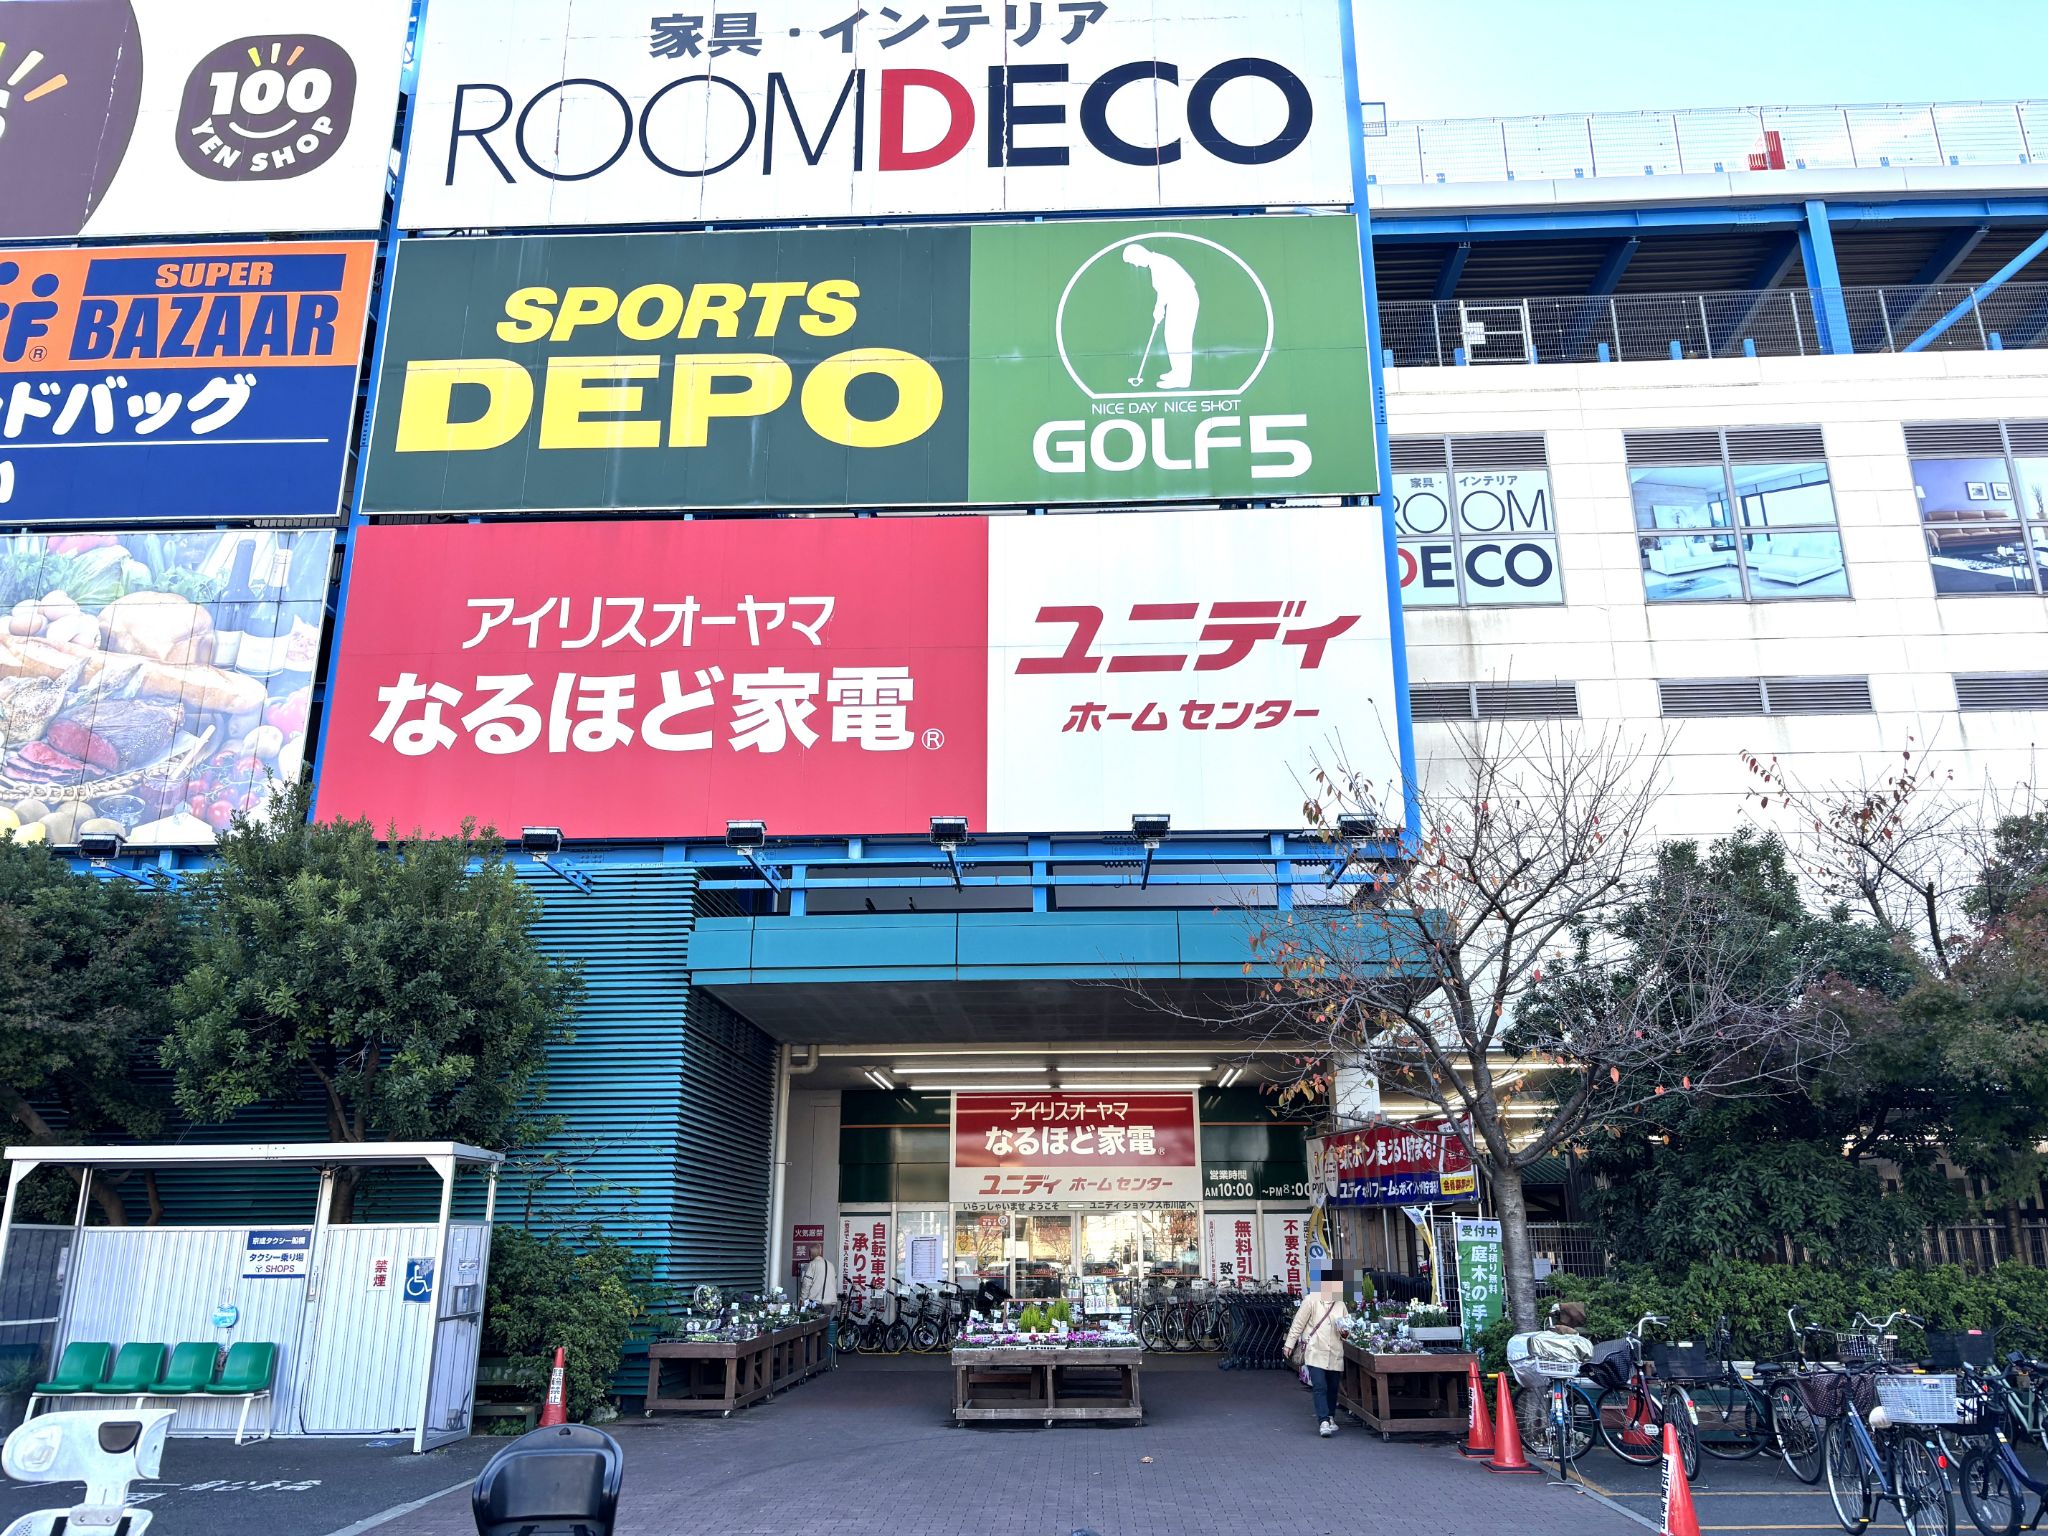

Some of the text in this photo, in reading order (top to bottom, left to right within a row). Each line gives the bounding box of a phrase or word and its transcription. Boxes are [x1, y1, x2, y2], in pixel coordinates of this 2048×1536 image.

[649, 1, 1109, 59] 家具・インテリア
[209, 67, 332, 115] 100
[191, 114, 336, 172] YEN SHOP
[155, 261, 274, 288] SUPER
[496, 280, 860, 343] SPORTS
[68, 294, 339, 361] BAZAAR
[0, 373, 257, 439] ドバッグ
[395, 347, 943, 453] DEPO
[1092, 399, 1241, 415] NICE DAY NICE SHOT
[462, 594, 836, 649] アイリスオーヤマ
[1014, 600, 1362, 675] ユニディ
[1010, 1101, 1128, 1121] アイリスオーヤマ
[978, 1174, 1062, 1195] ユニディ
[1209, 1169, 1248, 1180] 営業時間
[963, 1201, 1025, 1211] いらっしゃいませ
[1028, 1201, 1060, 1210] ようこそ
[1089, 1201, 1121, 1210] ユニディ
[794, 1228, 823, 1237] 火気厳禁
[1461, 1225, 1498, 1237] 受付中
[249, 1252, 304, 1262] タクシー乗り場
[265, 1264, 295, 1273] SHOPS
[1488, 1243, 1498, 1295] 見積り無料
[372, 1259, 389, 1287] 禁煙
